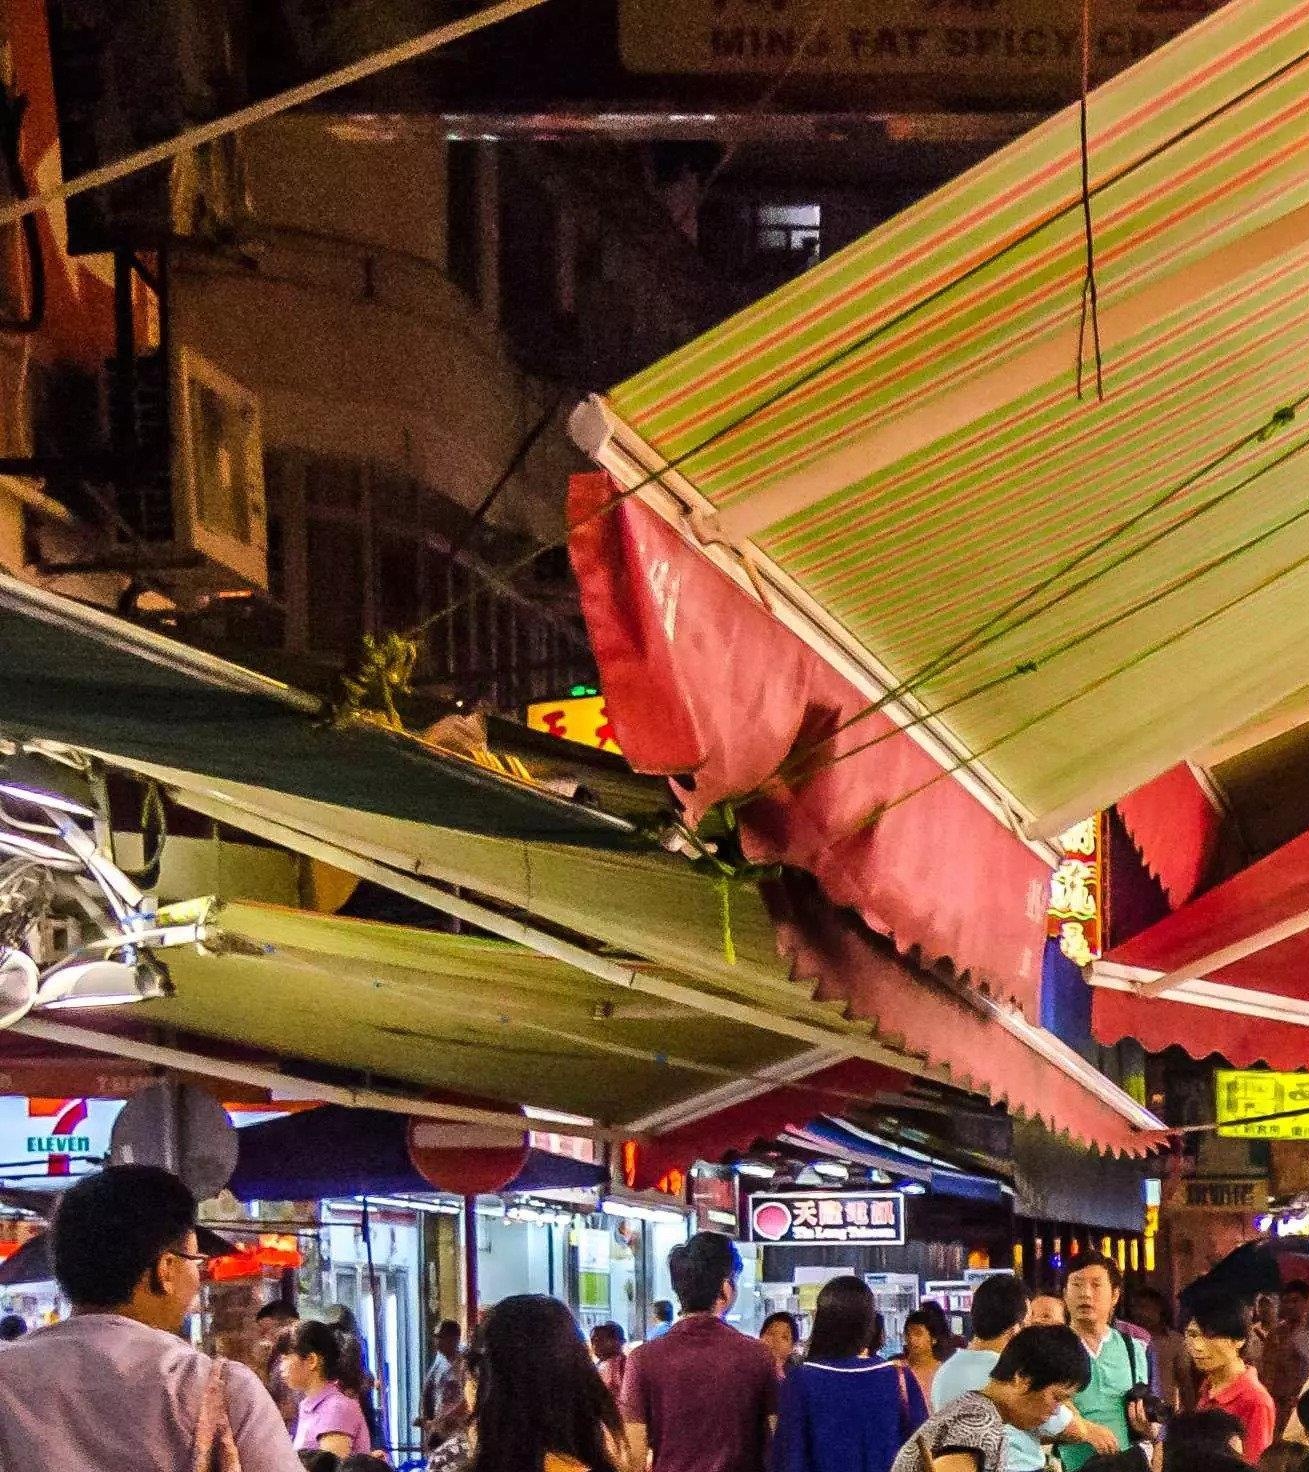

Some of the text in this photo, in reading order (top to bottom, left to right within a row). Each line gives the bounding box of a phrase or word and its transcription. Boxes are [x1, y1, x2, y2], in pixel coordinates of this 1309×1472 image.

[711, 27, 828, 57] MING
[850, 28, 927, 57] FAT
[947, 28, 1075, 58] SPICY
[28, 1097, 88, 1177] 7
